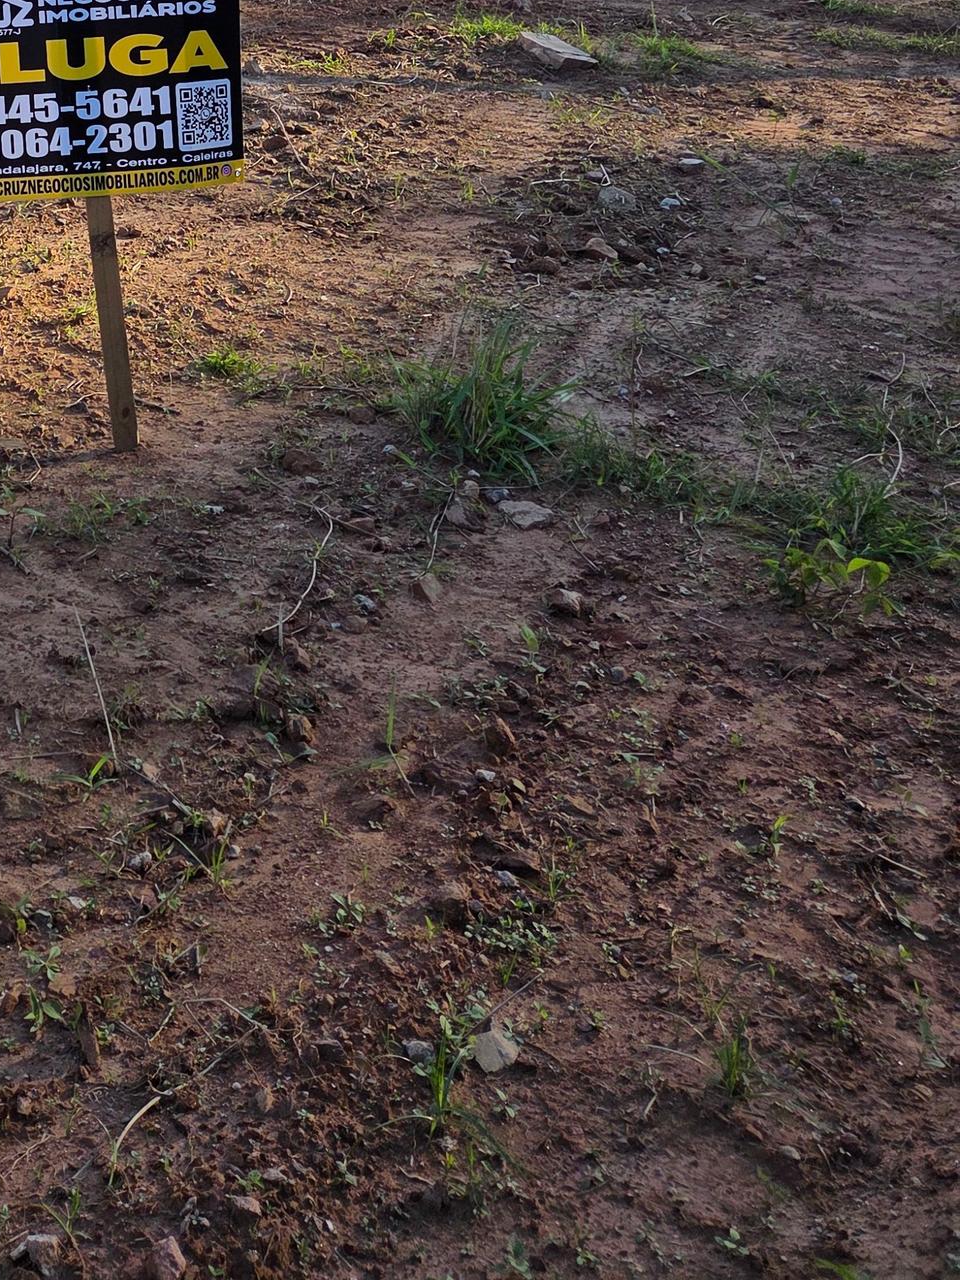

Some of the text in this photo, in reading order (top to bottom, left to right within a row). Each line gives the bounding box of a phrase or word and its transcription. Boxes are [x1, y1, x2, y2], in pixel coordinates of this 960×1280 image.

[37, 0, 217, 25] IMOBILIÁRIOS
[116, 157, 168, 168] Centro
[182, 150, 234, 163] Caleiras
